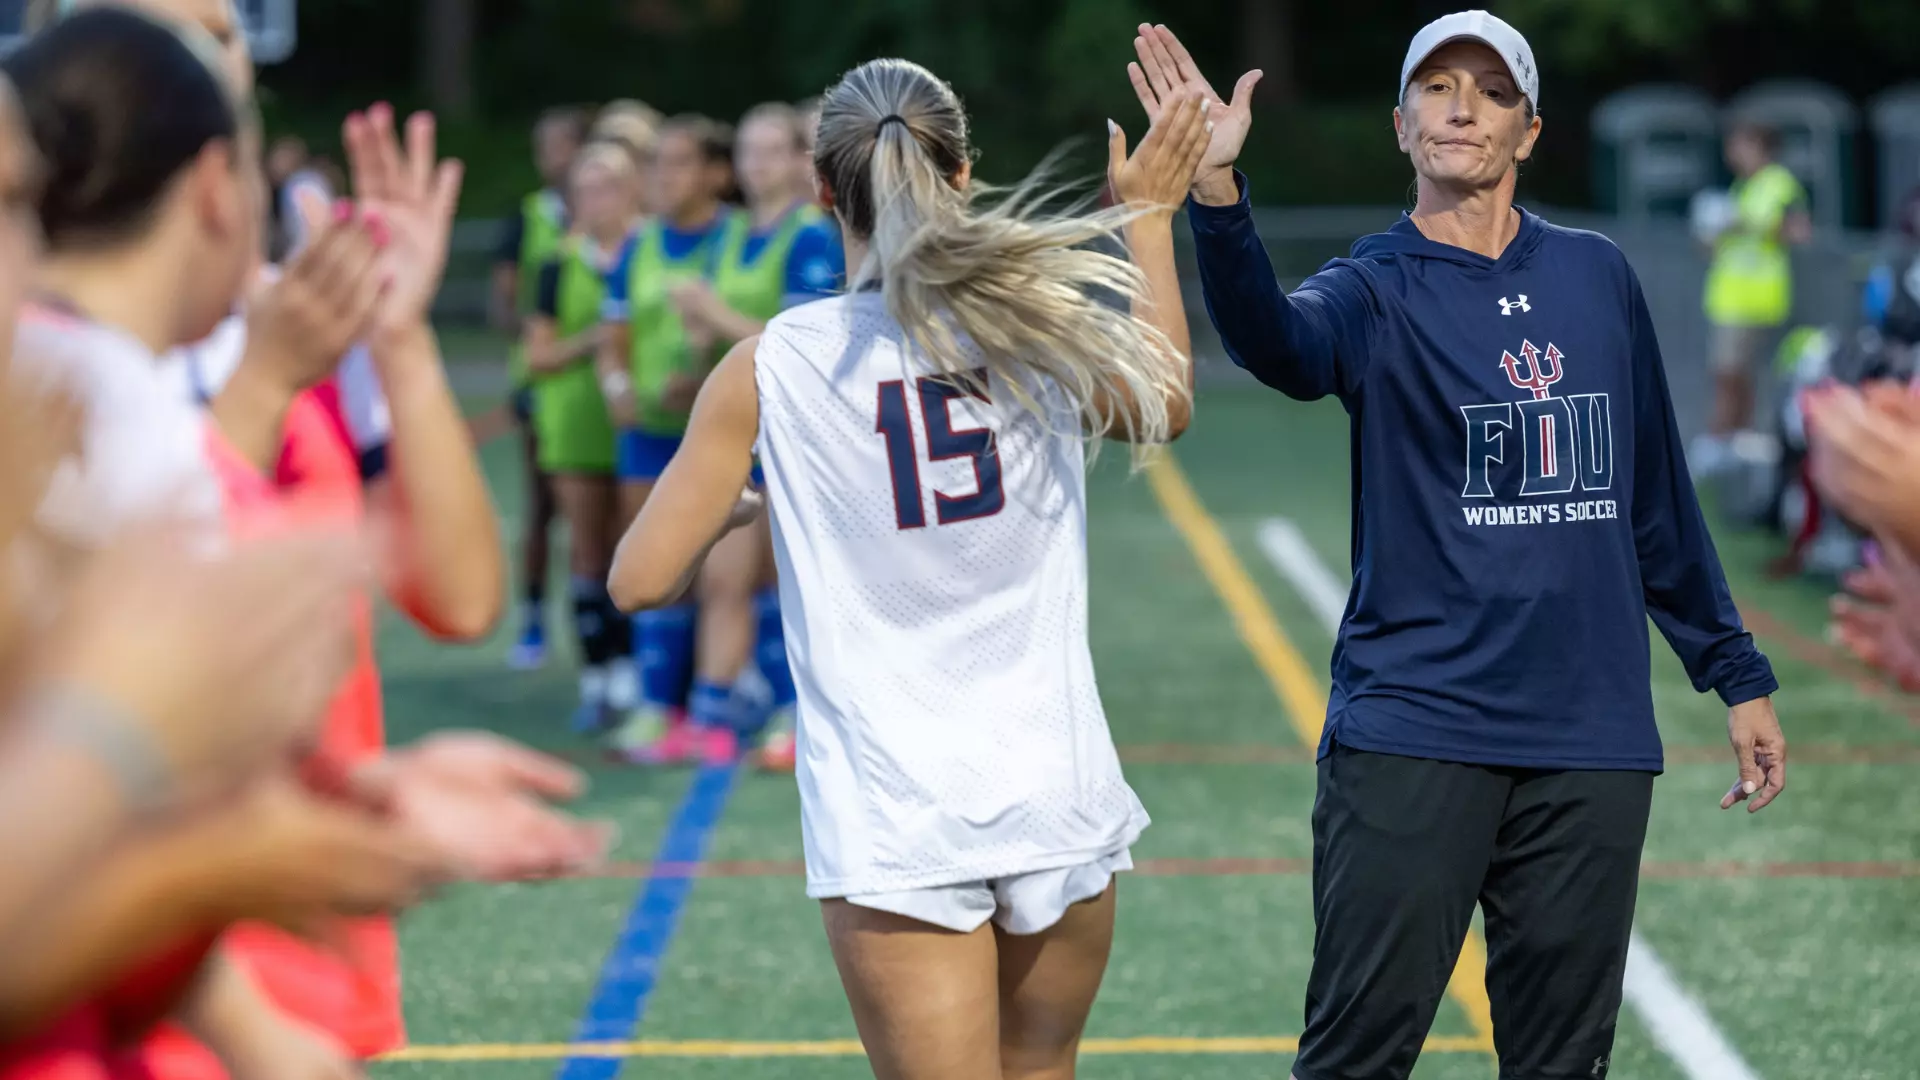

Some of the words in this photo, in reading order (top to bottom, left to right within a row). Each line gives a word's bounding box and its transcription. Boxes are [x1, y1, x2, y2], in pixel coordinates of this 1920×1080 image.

[876, 367, 1005, 530] 15
[1460, 393, 1612, 497] FDU
[1462, 504, 1561, 526] WOMEN'S
[1565, 500, 1617, 521] SOCCER
